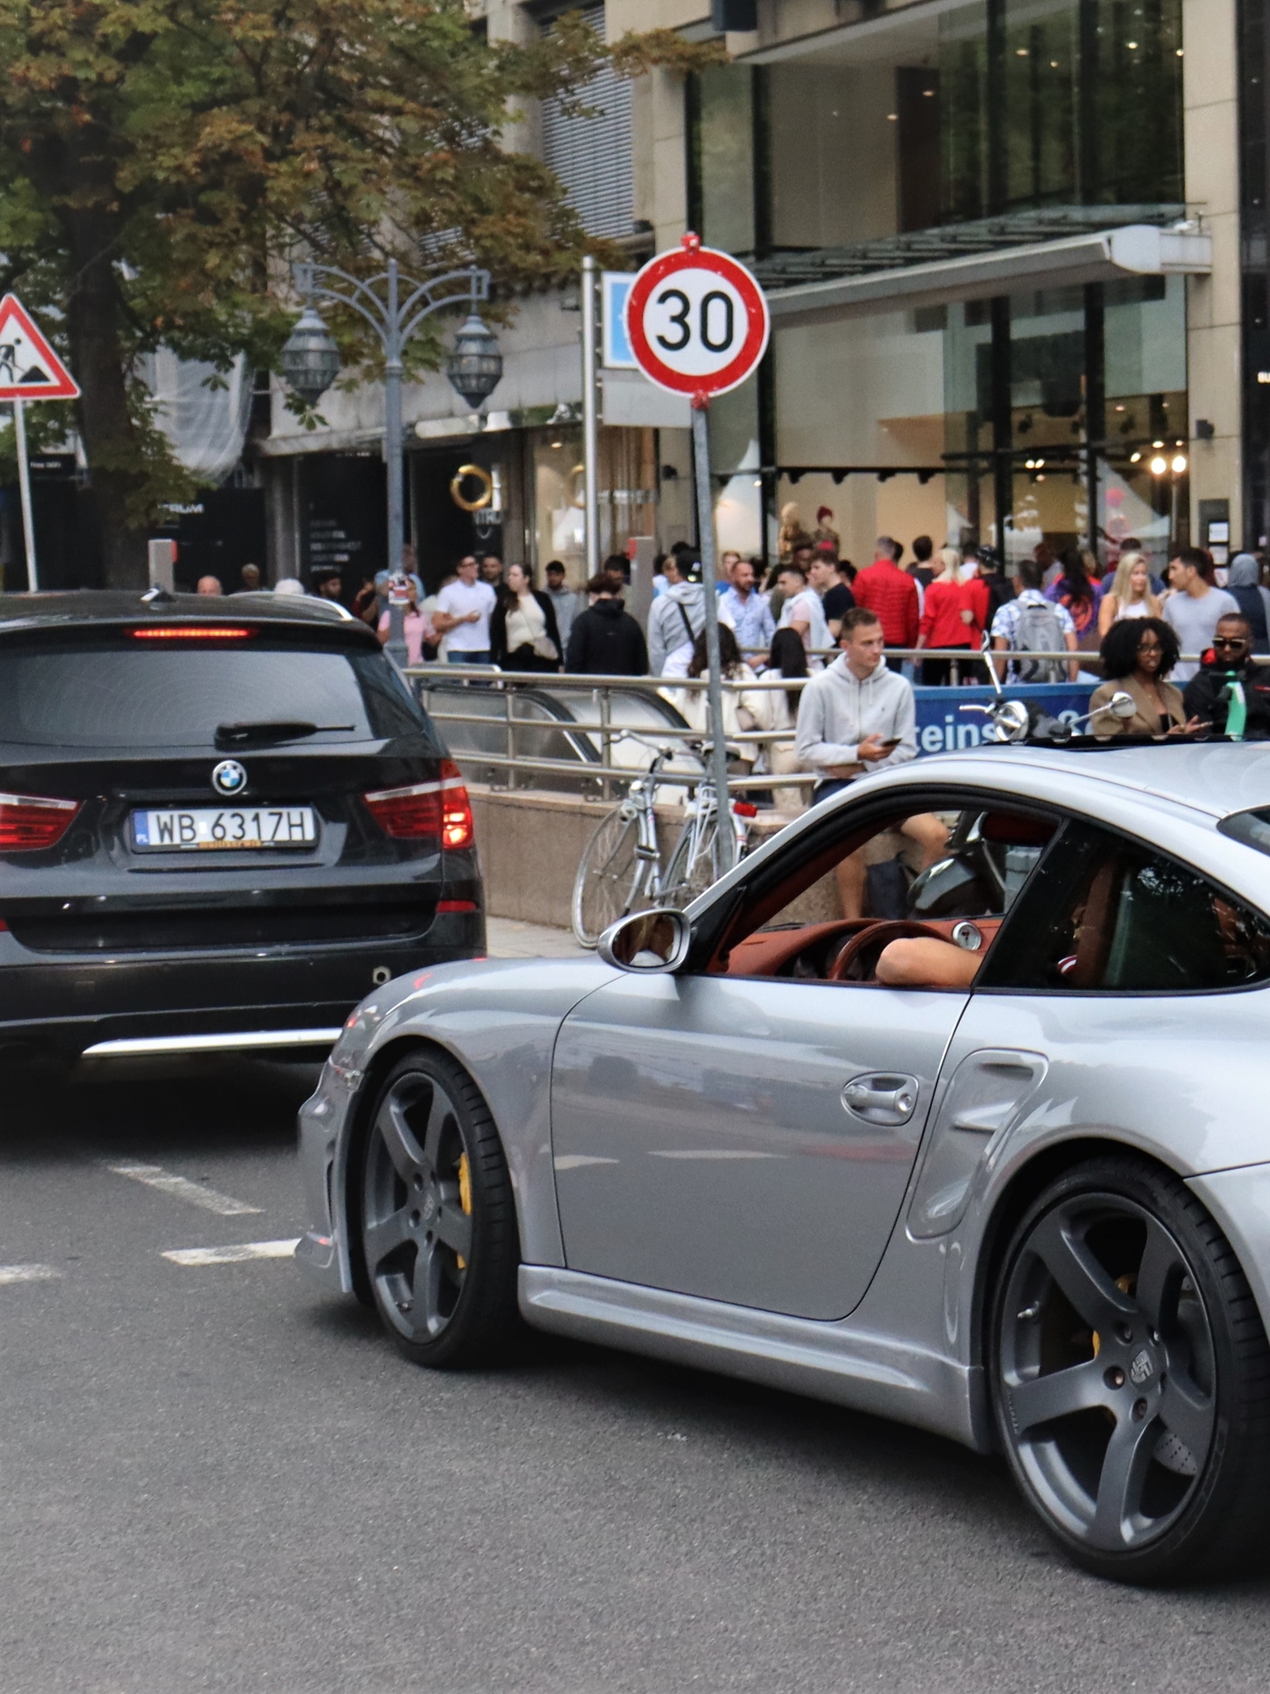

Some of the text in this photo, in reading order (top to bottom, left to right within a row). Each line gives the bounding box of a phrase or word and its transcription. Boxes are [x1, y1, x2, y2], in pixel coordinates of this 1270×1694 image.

[656, 289, 734, 353] 30
[156, 811, 306, 843] WB 6317H
